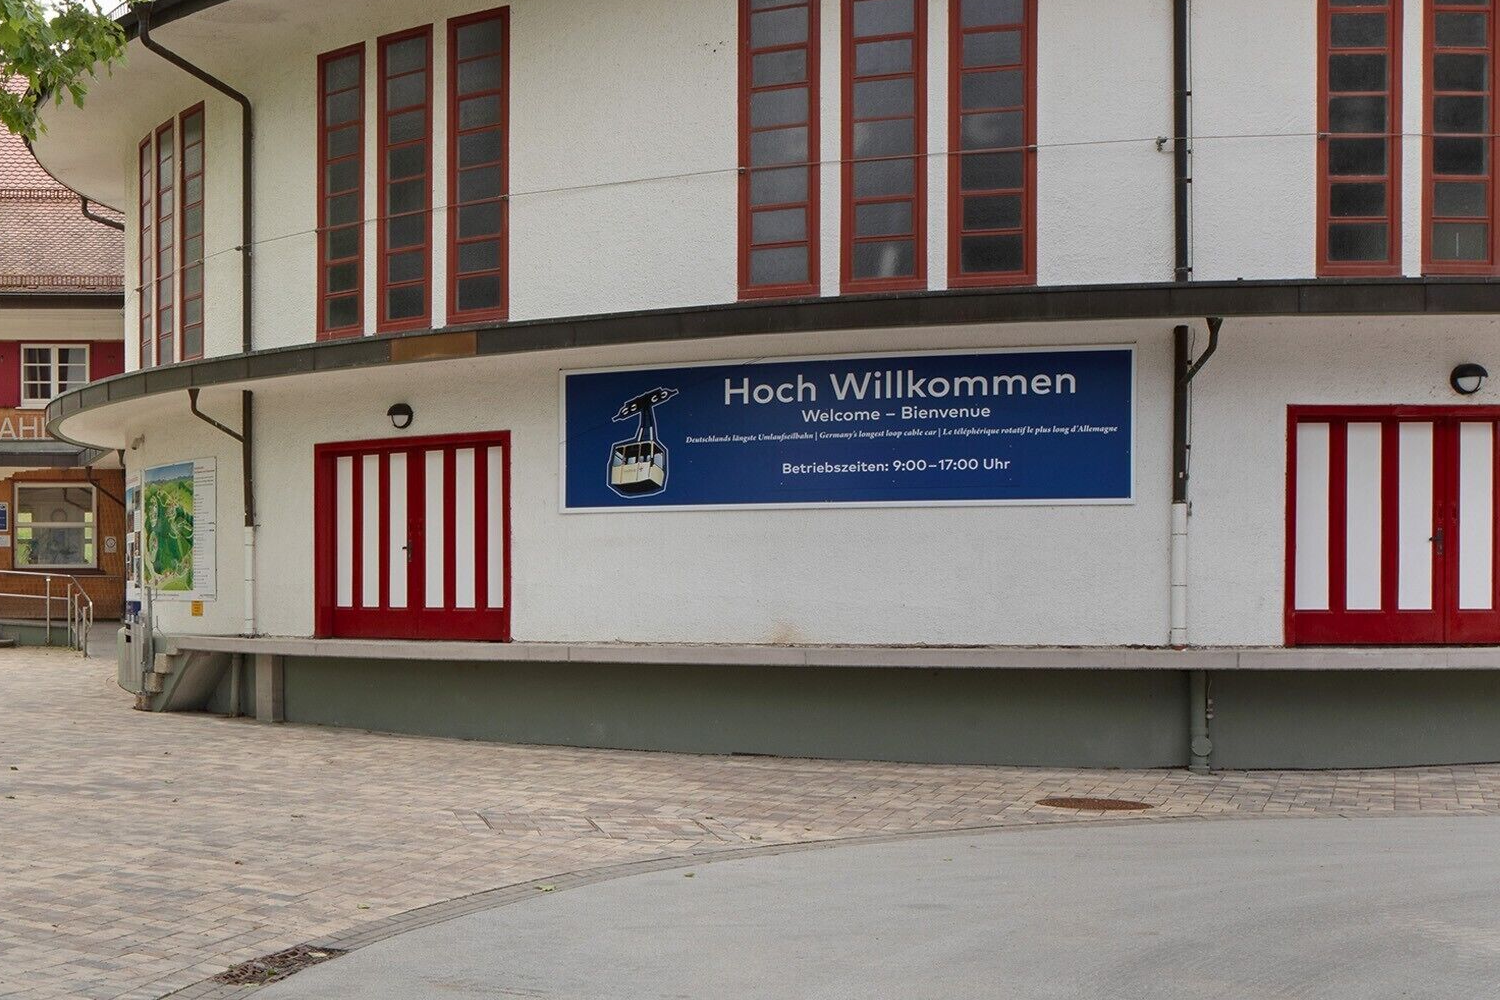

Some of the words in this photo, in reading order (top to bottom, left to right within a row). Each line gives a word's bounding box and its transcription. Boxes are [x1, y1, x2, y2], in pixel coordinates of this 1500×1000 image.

[724, 374, 817, 405] Hoch
[829, 369, 1077, 401] Willkommen
[801, 408, 881, 423] Welcome
[901, 405, 991, 420] Bienvenue
[685, 435, 731, 444] Deutschlands
[732, 433, 757, 443] längste
[758, 431, 814, 442] Umlaufseilbahn
[858, 429, 885, 439] longest
[885, 429, 903, 439] loop
[903, 428, 924, 437] cable
[924, 429, 937, 437] car
[942, 427, 952, 436] Le
[953, 426, 1000, 437] téléphérique
[1000, 425, 1027, 436] rotatif
[1026, 425, 1034, 434] le
[1034, 425, 1051, 436] plus
[1052, 425, 1070, 435] long
[781, 461, 889, 474] Betriebszeiten:
[983, 458, 1011, 470] Uhr
